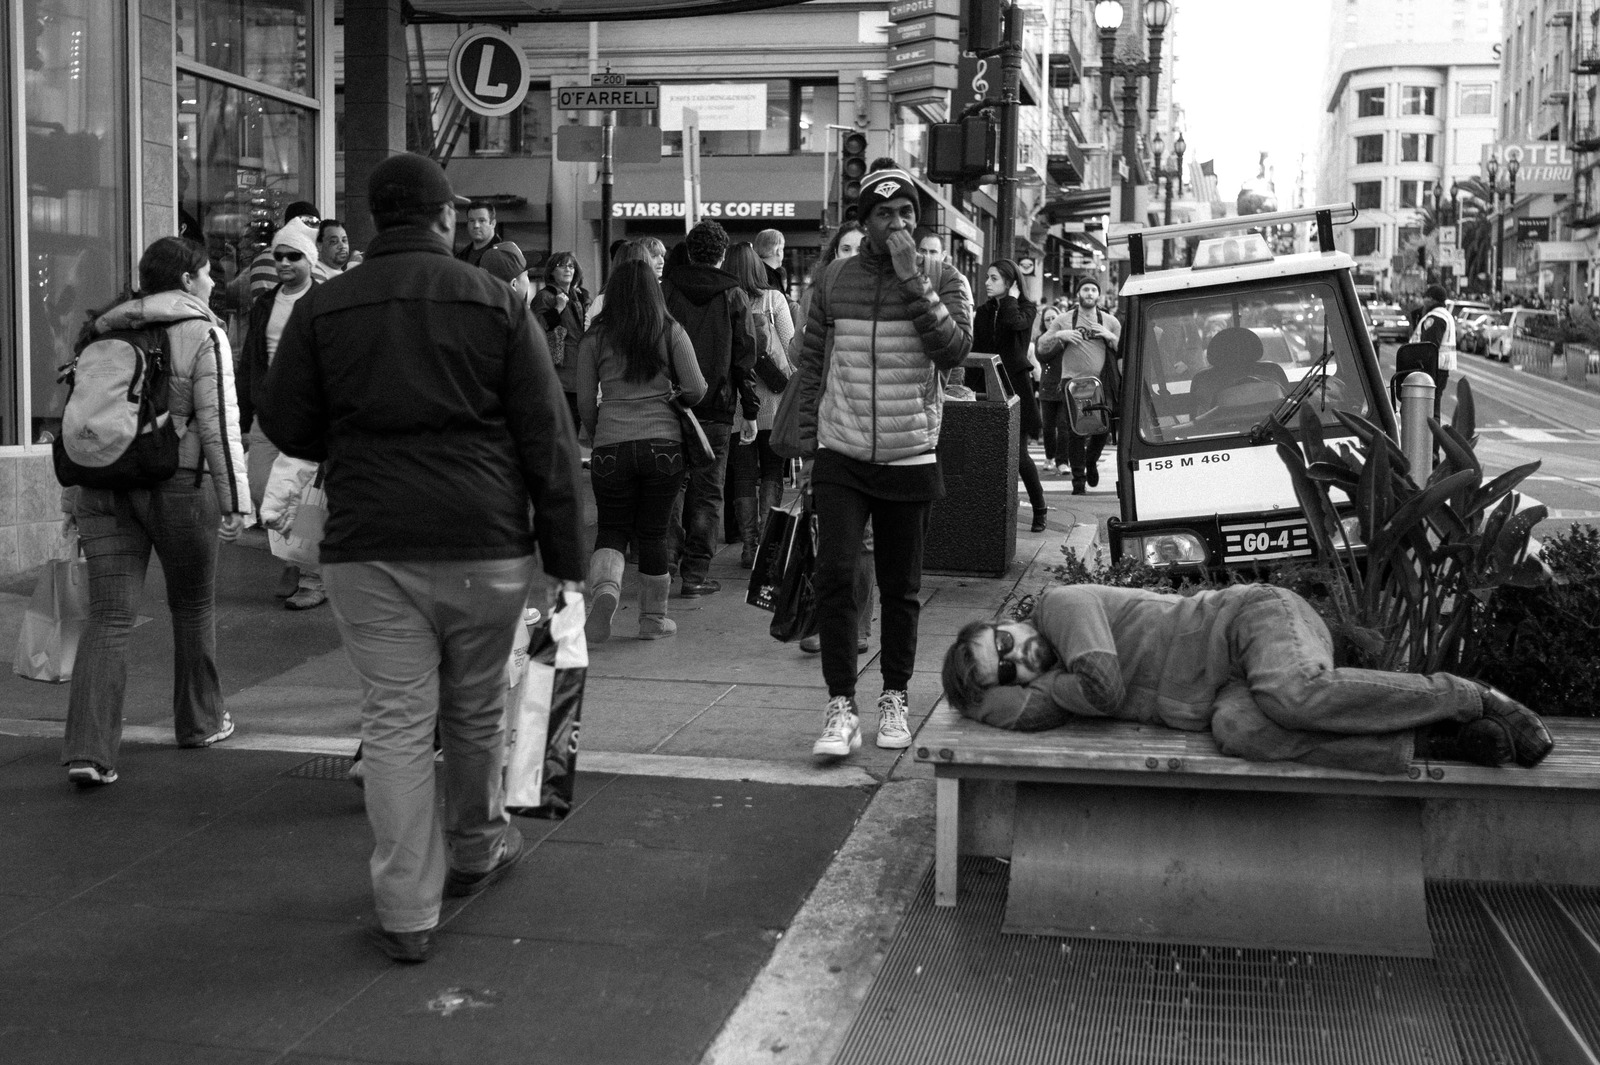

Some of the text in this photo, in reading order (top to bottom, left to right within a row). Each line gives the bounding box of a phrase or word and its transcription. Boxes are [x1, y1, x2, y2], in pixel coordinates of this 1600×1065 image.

[890, 0, 934, 16] CHIPOTLE
[475, 44, 508, 98] L
[603, 75, 622, 84] 200
[561, 91, 655, 105] O'FARRELL
[1486, 143, 1572, 165] HOTEL
[1495, 166, 1573, 181] ATFORD
[612, 202, 795, 217] STARBUKS COFFEE
[1146, 453, 1231, 471] 158 M 460
[1244, 530, 1289, 552] GO-4
